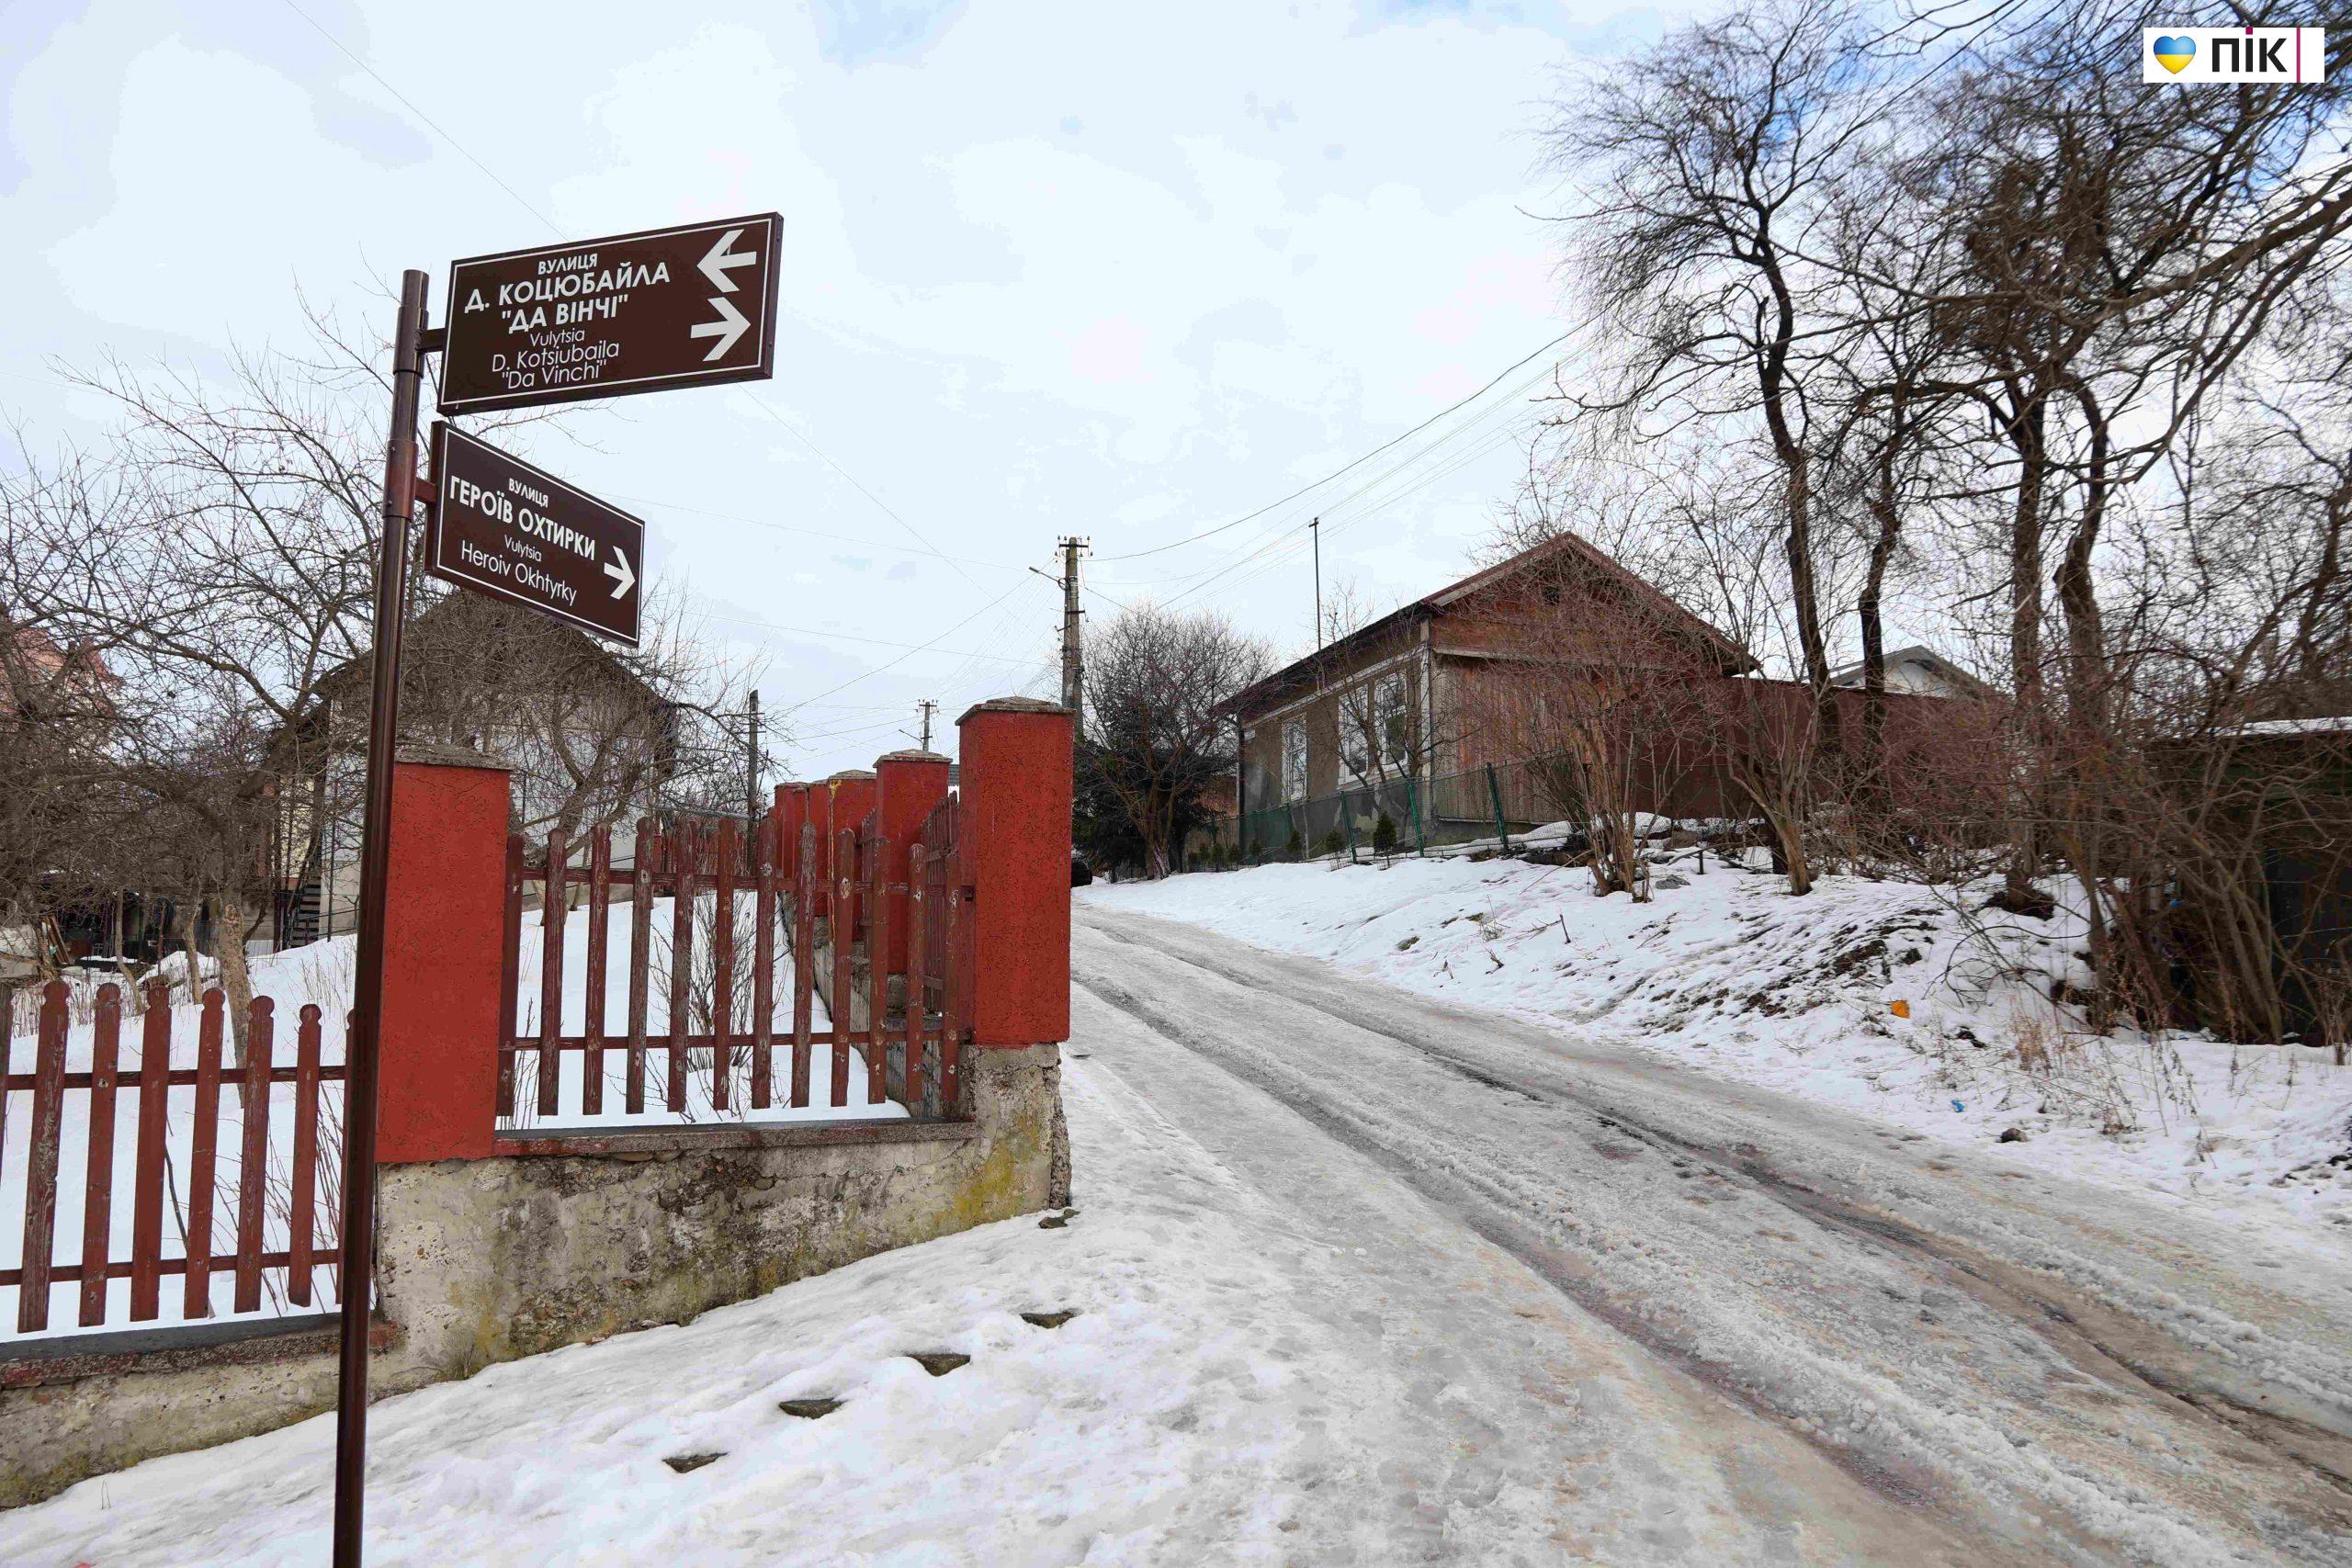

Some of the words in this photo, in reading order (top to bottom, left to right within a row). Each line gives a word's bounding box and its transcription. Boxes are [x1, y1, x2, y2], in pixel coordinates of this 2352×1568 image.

[537, 253, 598, 276] ВУЛИЦЯ
[464, 288, 490, 313] Д.
[499, 262, 670, 306] КОЦЮБАЙЛА
[530, 328, 585, 348] Vulytsia
[492, 353, 511, 372] D.
[517, 341, 619, 368] Kotsiubaila
[508, 478, 548, 508] ВУЛИЦЯ
[450, 475, 513, 524] ГЕРОЇВ
[518, 508, 595, 561] ОХТИРКИ
[504, 535, 542, 562] Vulytsia
[461, 540, 511, 576] Heroiv
[514, 562, 578, 606] Okhtyrky
